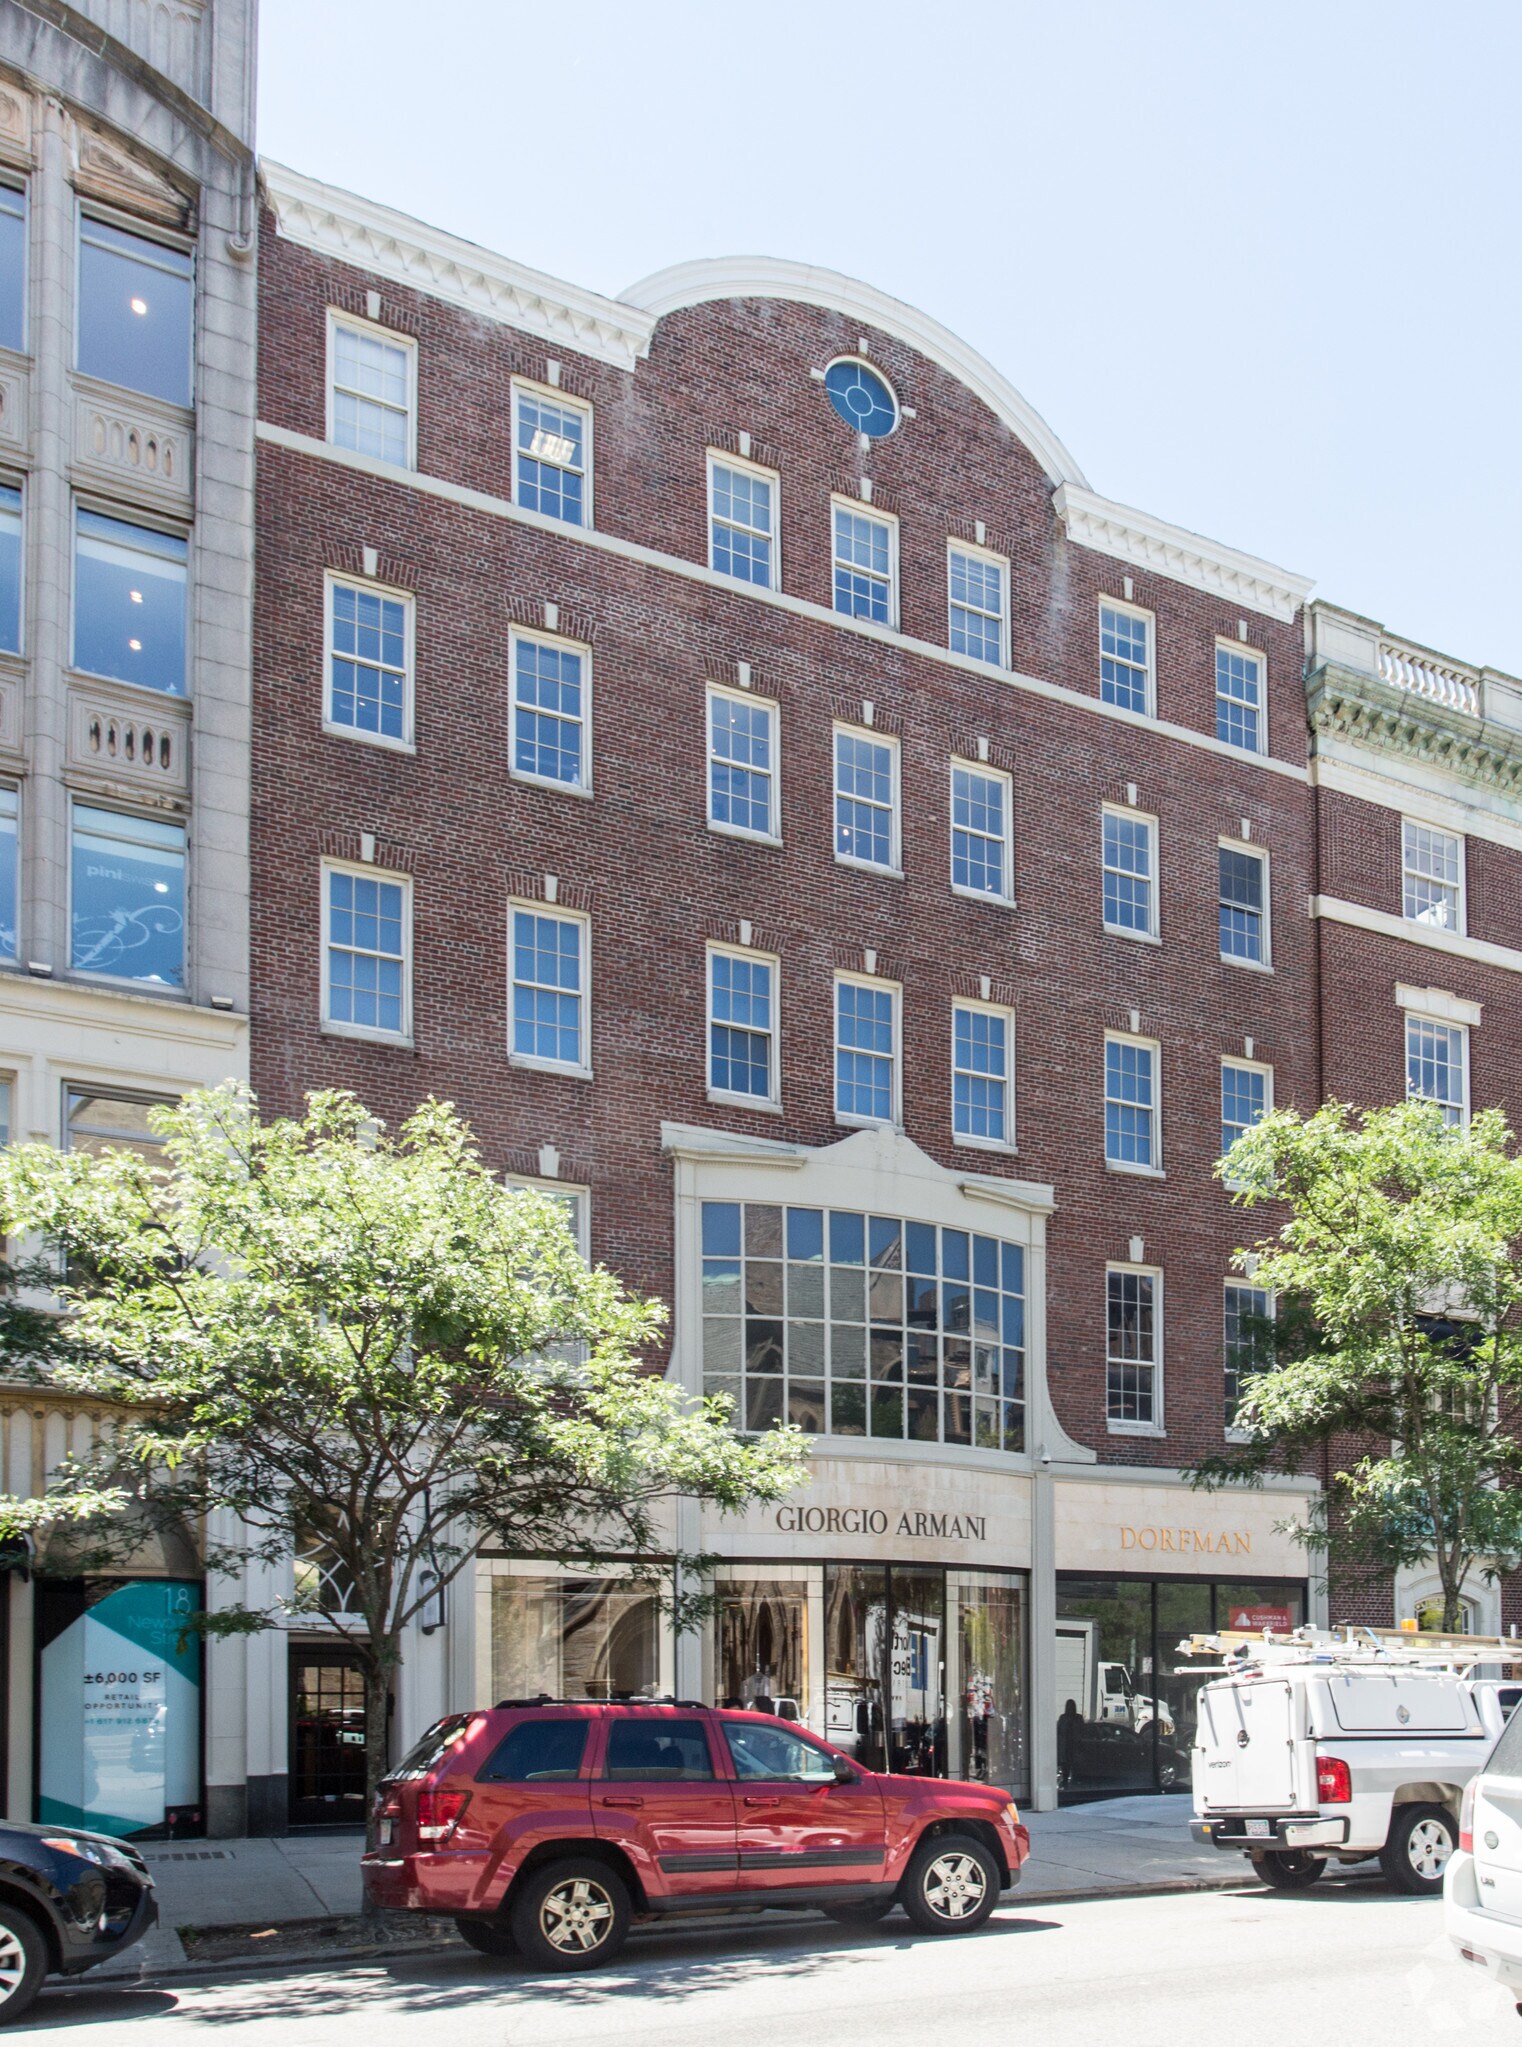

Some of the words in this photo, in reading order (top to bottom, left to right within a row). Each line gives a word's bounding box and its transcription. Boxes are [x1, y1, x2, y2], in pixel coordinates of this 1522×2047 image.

[776, 1506, 888, 1534] GIORGIO
[896, 1512, 986, 1540] ARMANI
[1120, 1527, 1252, 1553] DORFMAN
[164, 1587, 191, 1615] 18
[128, 1615, 188, 1630] Newb
[83, 1672, 138, 1684] ±6,000
[143, 1672, 161, 1683] SF
[1208, 1760, 1232, 1769] verizon
